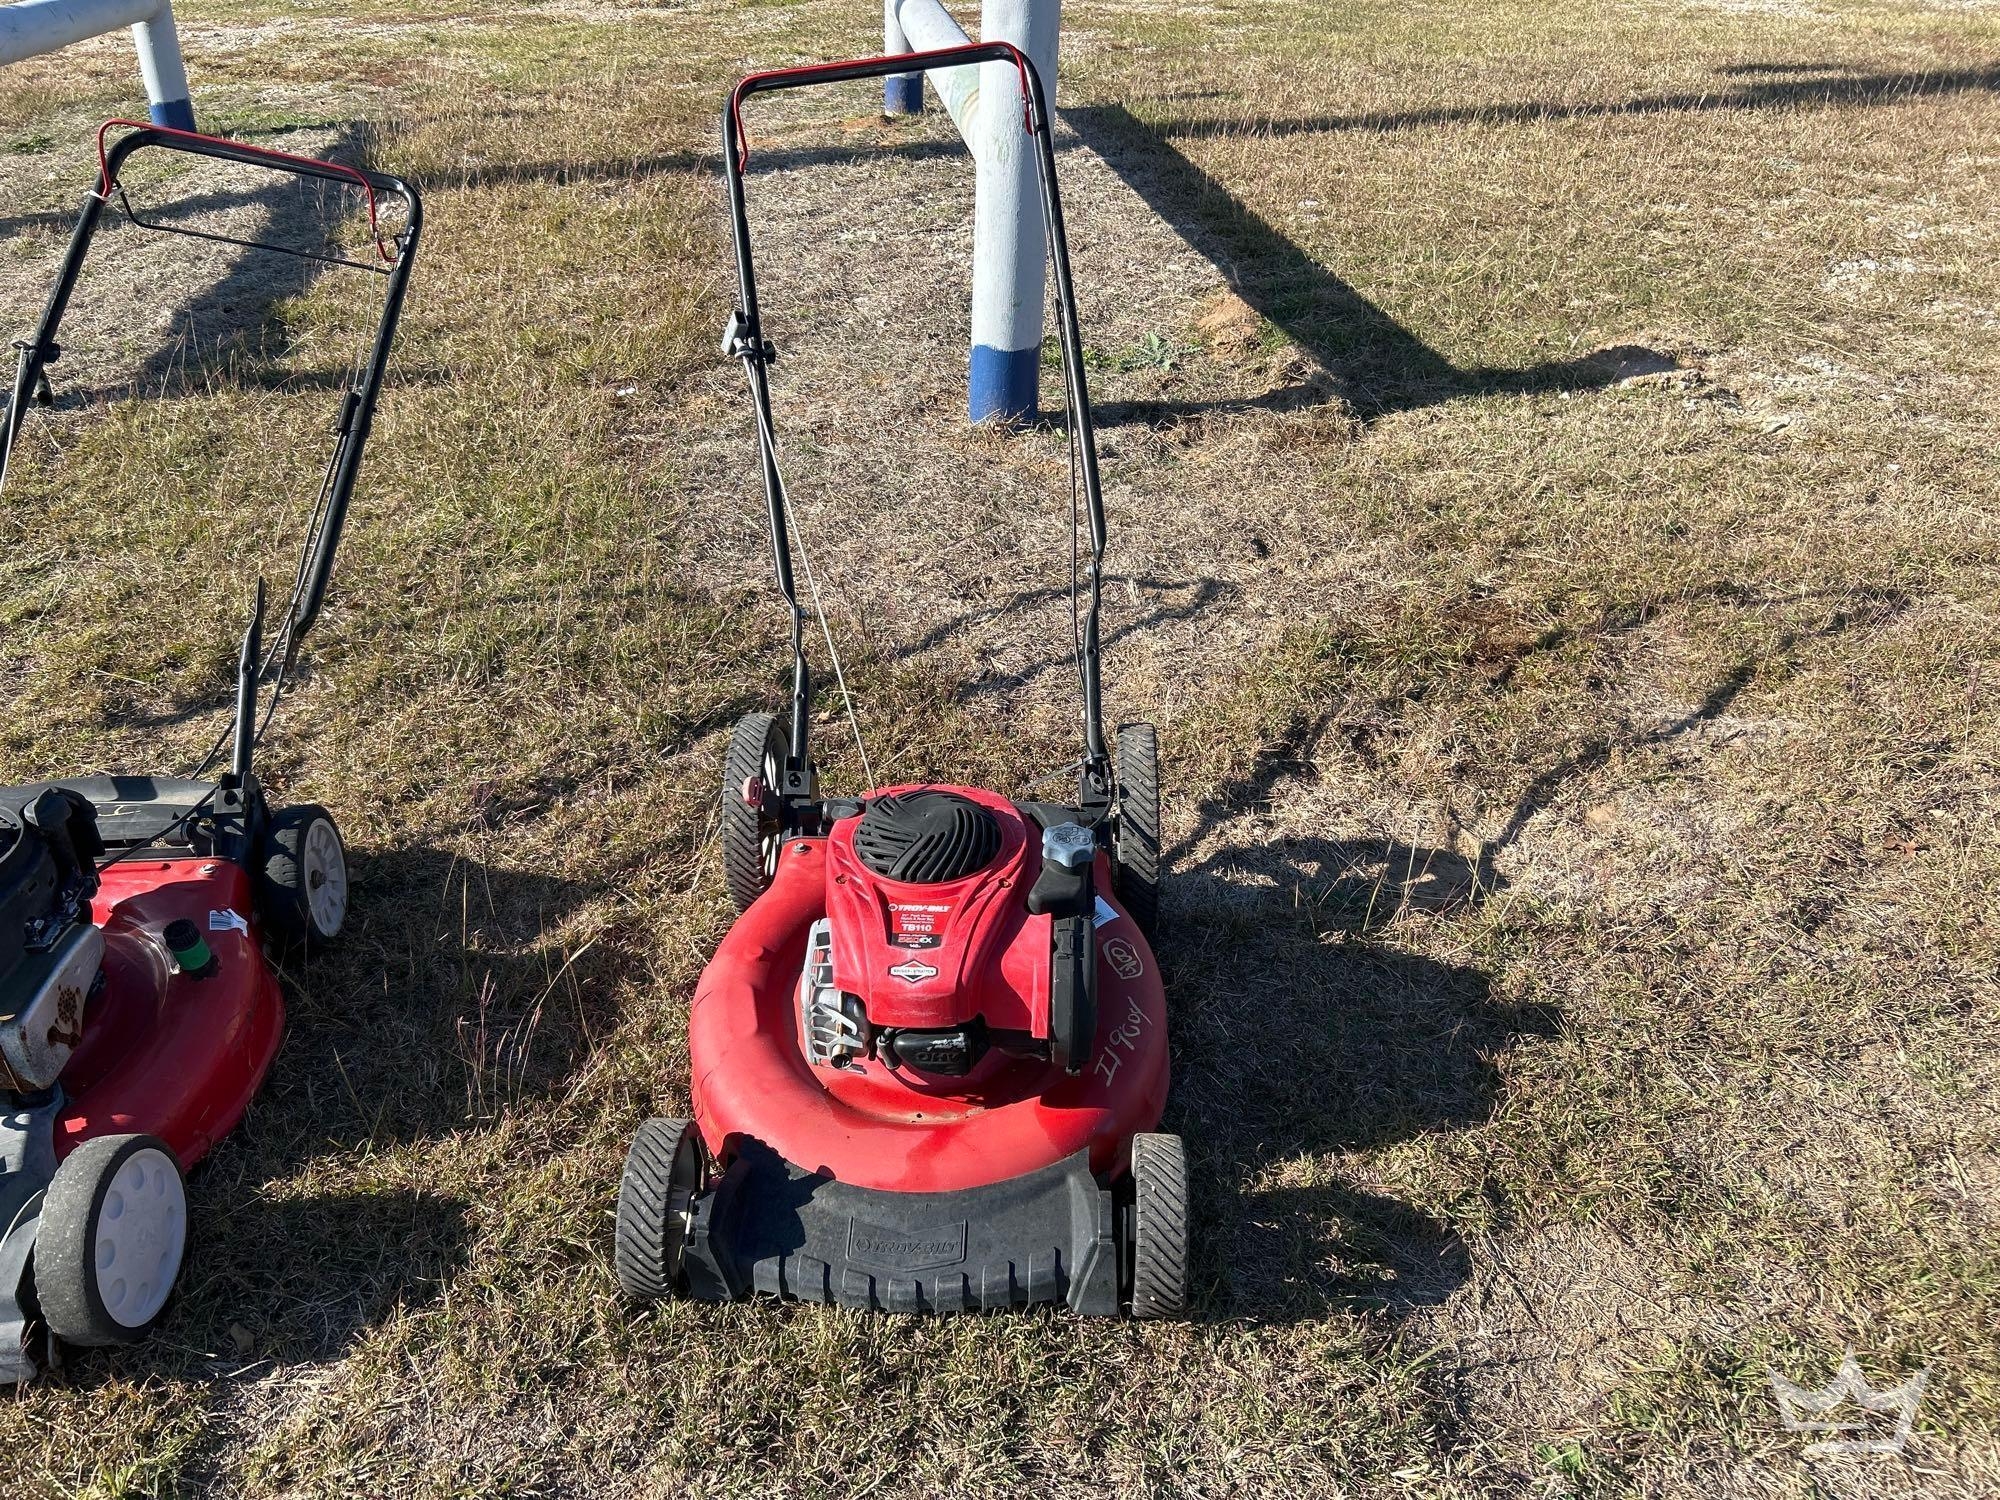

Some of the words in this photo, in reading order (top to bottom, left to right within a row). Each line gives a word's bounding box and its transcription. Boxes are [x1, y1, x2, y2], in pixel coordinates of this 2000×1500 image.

[898, 904, 952, 912] TROY-BILT
[901, 923, 932, 932] TB110
[872, 1239, 960, 1256] TROY-BILT
